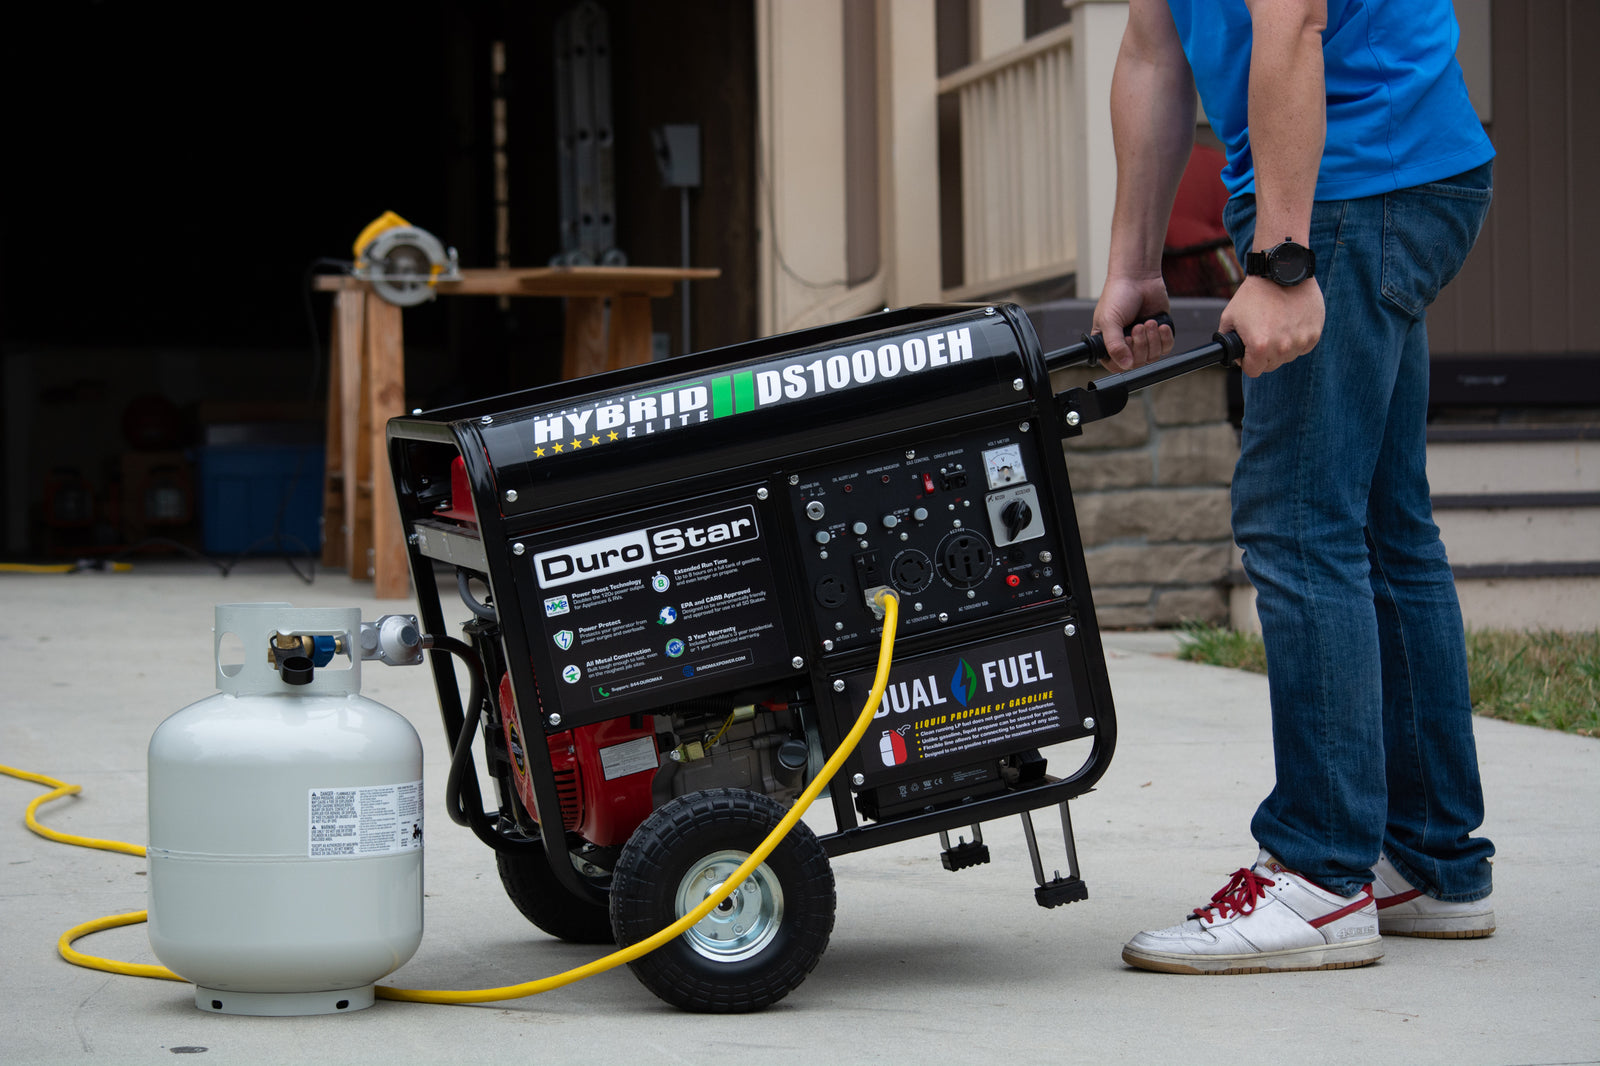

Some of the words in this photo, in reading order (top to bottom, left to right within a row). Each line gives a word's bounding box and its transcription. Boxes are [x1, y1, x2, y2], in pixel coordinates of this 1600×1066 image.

[756, 327, 973, 405] DS10000EH
[533, 385, 708, 445] HYBRID
[626, 410, 709, 439] ELITE
[541, 543, 645, 582] Duro
[652, 518, 751, 555] Star
[674, 564, 701, 575] Extended
[713, 557, 728, 566] Time
[697, 574, 712, 582] longer
[571, 590, 591, 599] Power
[591, 585, 610, 595] Boost
[610, 578, 642, 591] Technology
[573, 596, 592, 605] Doubles
[582, 599, 607, 609] Appliances
[680, 601, 694, 609] EPA
[705, 594, 723, 603] CARB
[723, 587, 751, 600] Approved
[682, 605, 704, 615] Designed
[749, 590, 767, 599] friendly
[692, 609, 714, 618] approved
[578, 624, 598, 633] Power
[598, 618, 621, 629] Protect
[580, 630, 601, 639] Protects
[612, 622, 635, 632] generator
[693, 632, 708, 640] Year
[707, 626, 736, 637] Warranty
[596, 634, 613, 642] surges
[689, 638, 708, 647] Includes
[711, 637, 738, 647] commercial
[594, 656, 613, 665] Metal
[613, 647, 652, 660] Construction
[612, 659, 630, 667] enough
[696, 655, 746, 671] DUROMAXPOWER.COM
[603, 666, 625, 675] roughest
[630, 676, 663, 688] 844-DUROMAX
[868, 675, 947, 720] DUAL
[982, 650, 1053, 693] FUEL
[914, 716, 947, 730] LIQUID
[950, 704, 992, 722] PROPANE
[995, 702, 1006, 711] or
[1009, 690, 1054, 708] GASOLINE
[935, 725, 954, 734] running
[938, 731, 963, 741] gasoline,
[977, 723, 998, 731] propane
[923, 742, 944, 751] Flexible
[980, 727, 1009, 738] connecting
[924, 749, 945, 758] Designed
[964, 741, 982, 750] gasoline
